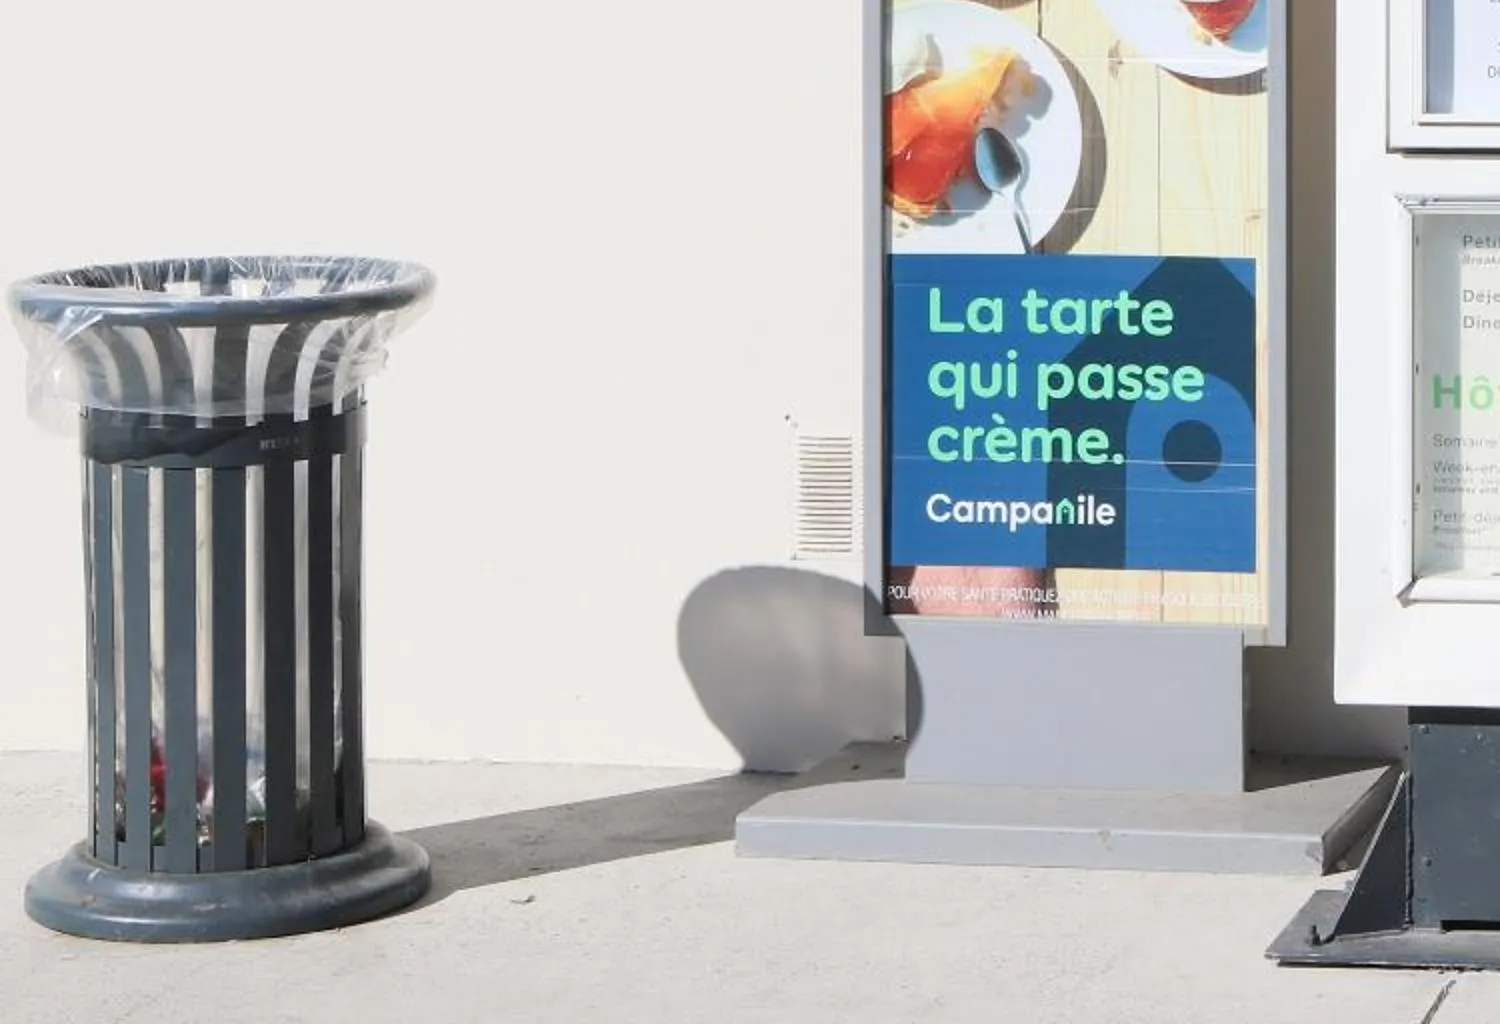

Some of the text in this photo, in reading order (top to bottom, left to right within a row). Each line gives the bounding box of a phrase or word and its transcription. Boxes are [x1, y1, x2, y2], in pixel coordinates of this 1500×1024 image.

[927, 286, 1175, 337] La tarte
[927, 348, 1206, 411] qui passe
[926, 412, 1125, 465] crème.
[925, 492, 1118, 533] Campanile
[887, 584, 918, 600] POUR
